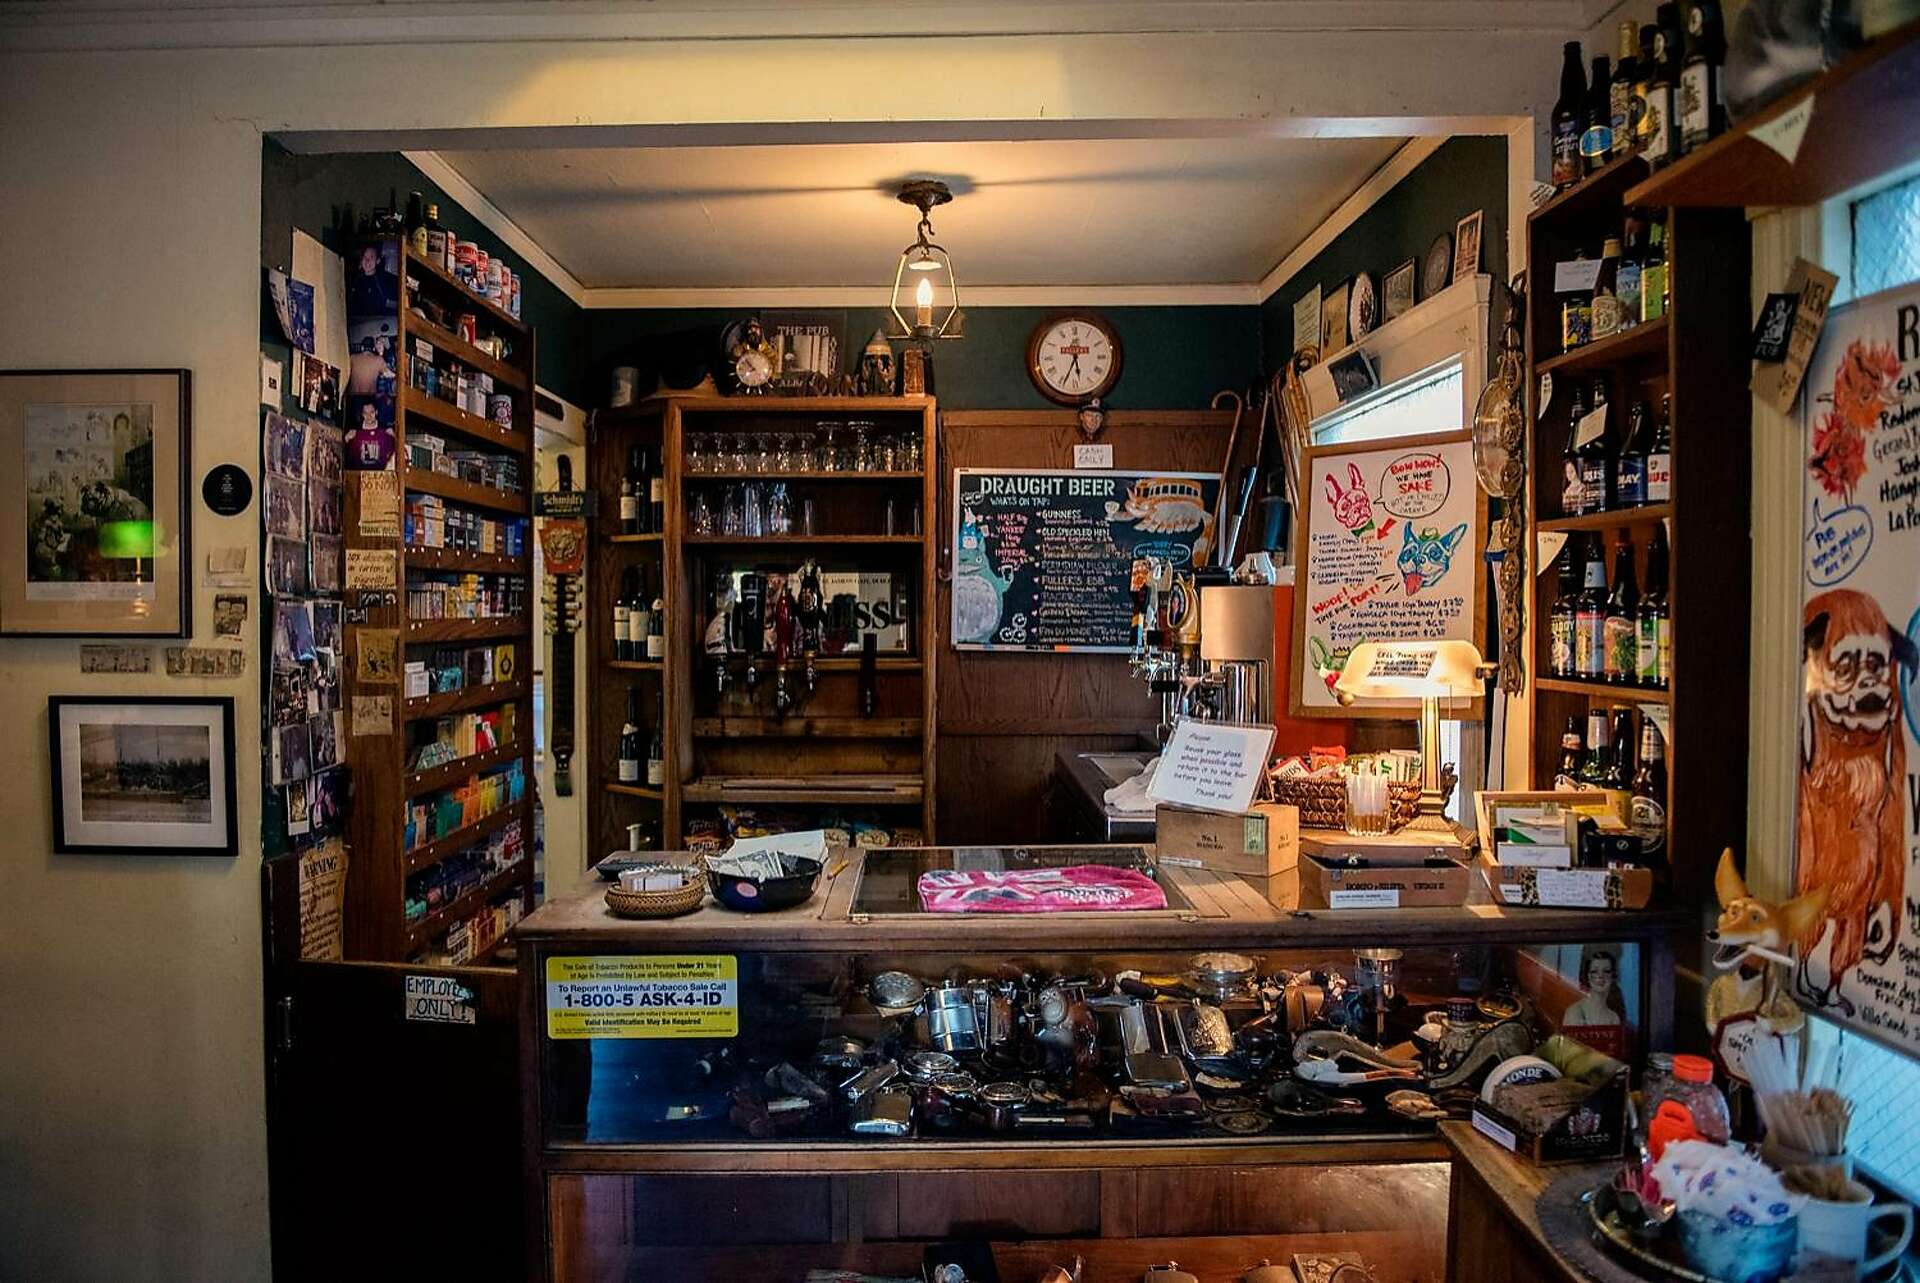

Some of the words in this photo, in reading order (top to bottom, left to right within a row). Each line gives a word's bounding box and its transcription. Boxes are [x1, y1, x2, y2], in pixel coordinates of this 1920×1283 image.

[980, 477, 1063, 496] DRAUGHT
[1068, 478, 1116, 496] BEER
[1041, 509, 1081, 519] GUINNESS
[677, 962, 695, 970] Under
[578, 972, 589, 981] Age
[558, 984, 569, 993] To
[570, 984, 600, 994] Report
[614, 984, 650, 992] Unlawful
[652, 984, 688, 992] Tobacco
[690, 983, 709, 991] Sale
[710, 983, 727, 991] Call
[564, 993, 634, 1007] 1-800-5
[639, 992, 722, 1006] ASK-4-ID
[584, 1018, 600, 1026] Valid
[602, 1018, 645, 1026] Identification
[646, 1018, 661, 1026] May
[672, 1017, 702, 1026] Required
